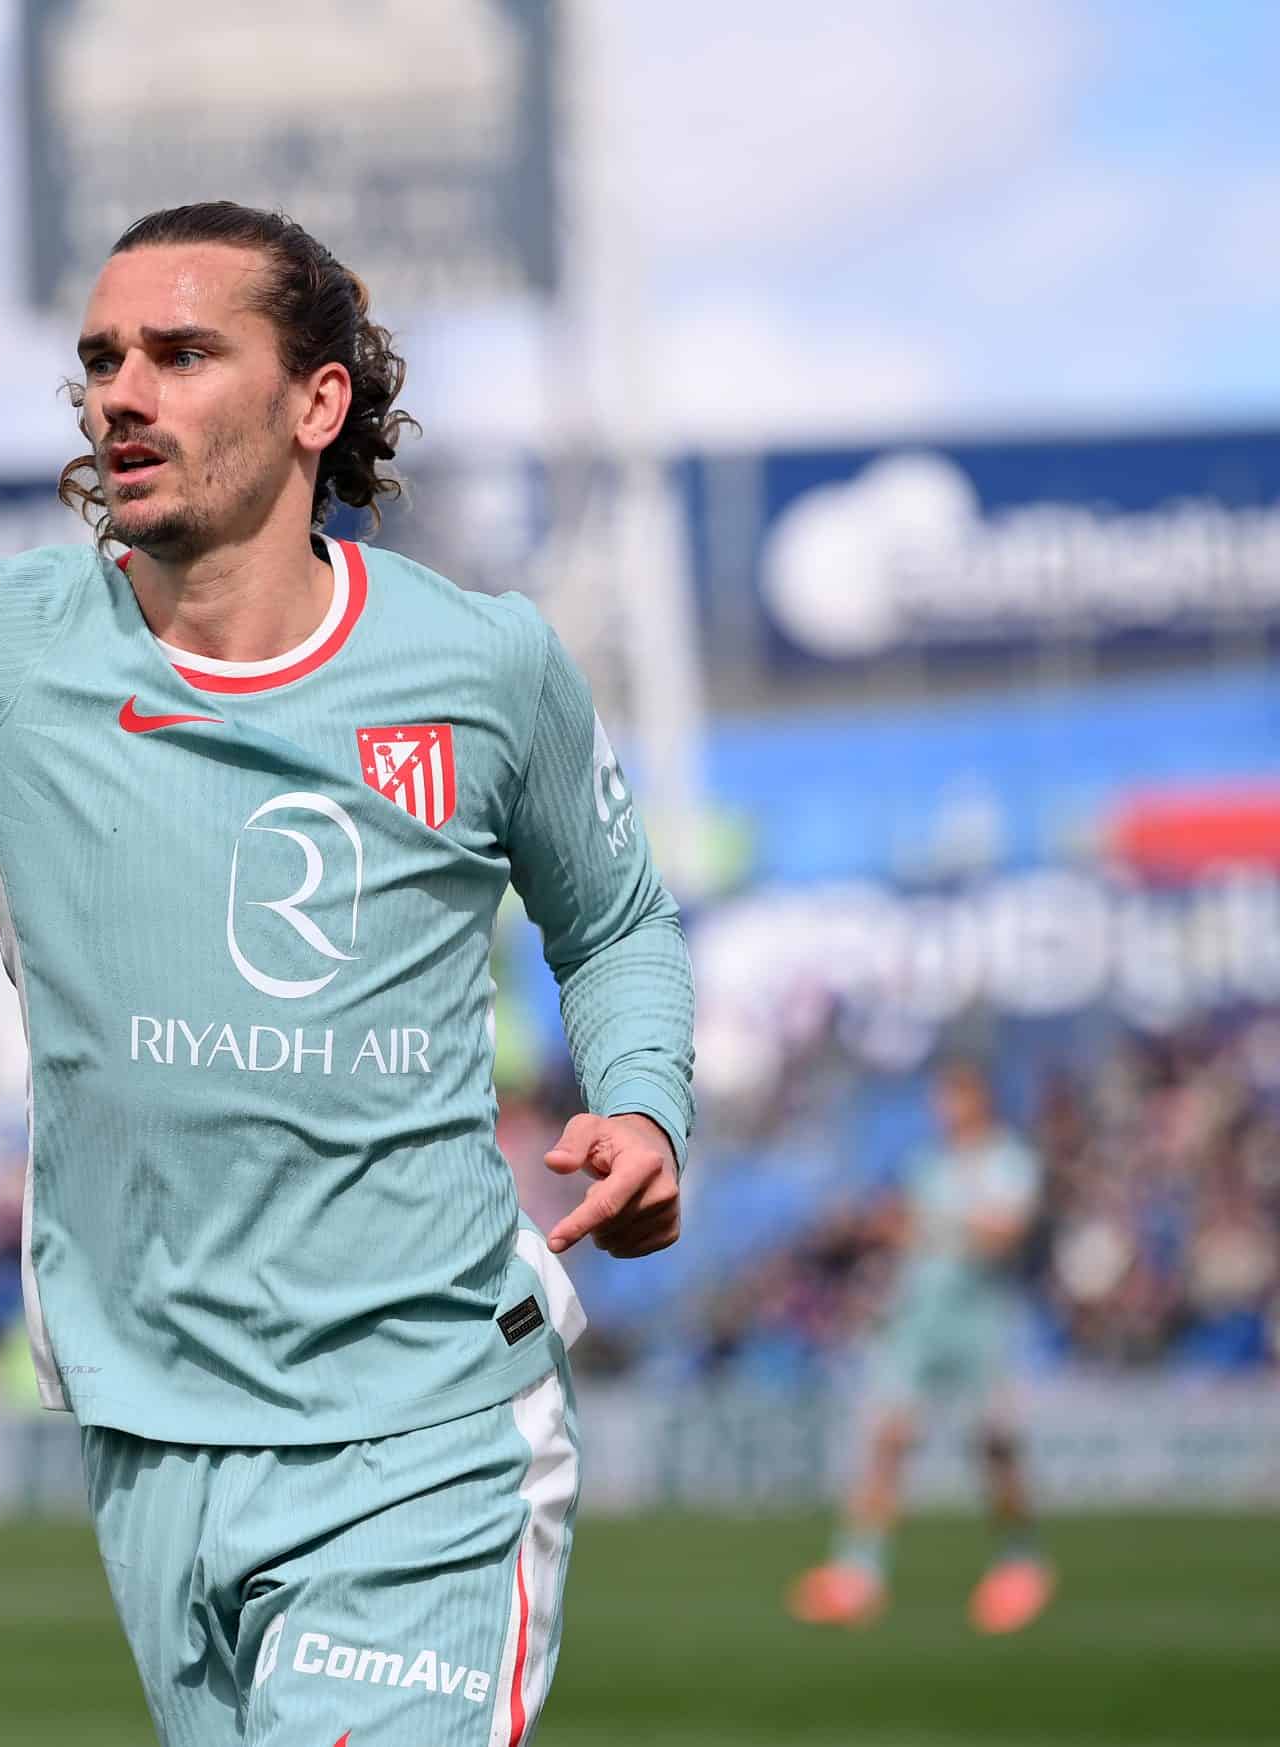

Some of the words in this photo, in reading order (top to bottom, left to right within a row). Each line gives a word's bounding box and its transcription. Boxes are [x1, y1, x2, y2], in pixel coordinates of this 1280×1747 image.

[130, 1015, 333, 1075] RIYADH
[350, 1027, 432, 1075] AIR
[292, 1631, 491, 1703] ComAve
